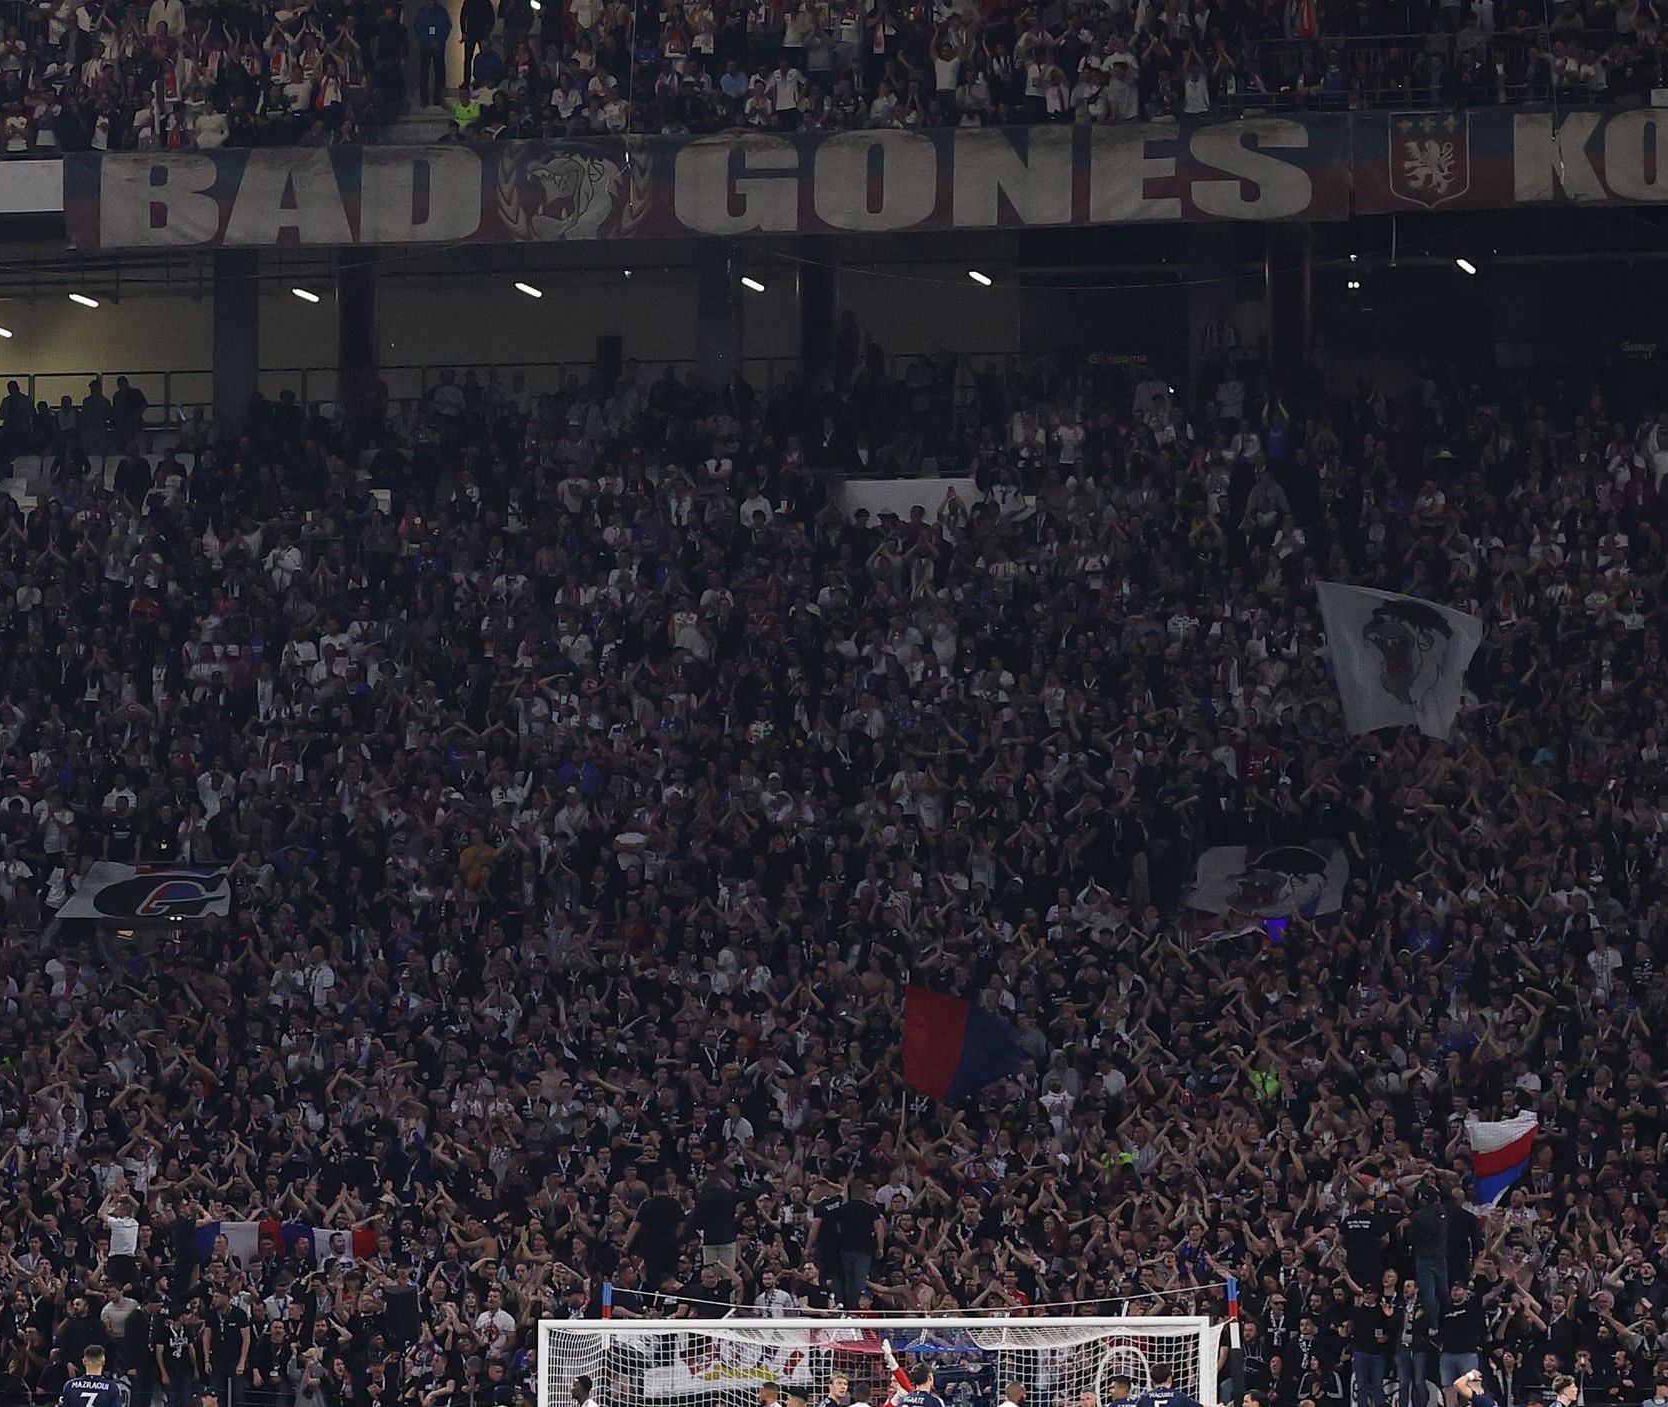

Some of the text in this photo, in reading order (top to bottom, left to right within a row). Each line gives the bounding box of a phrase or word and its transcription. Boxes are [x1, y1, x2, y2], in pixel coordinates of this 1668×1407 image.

[100, 118, 1313, 248] BAD GONES
[72, 1380, 110, 1391] MAZRAOUI
